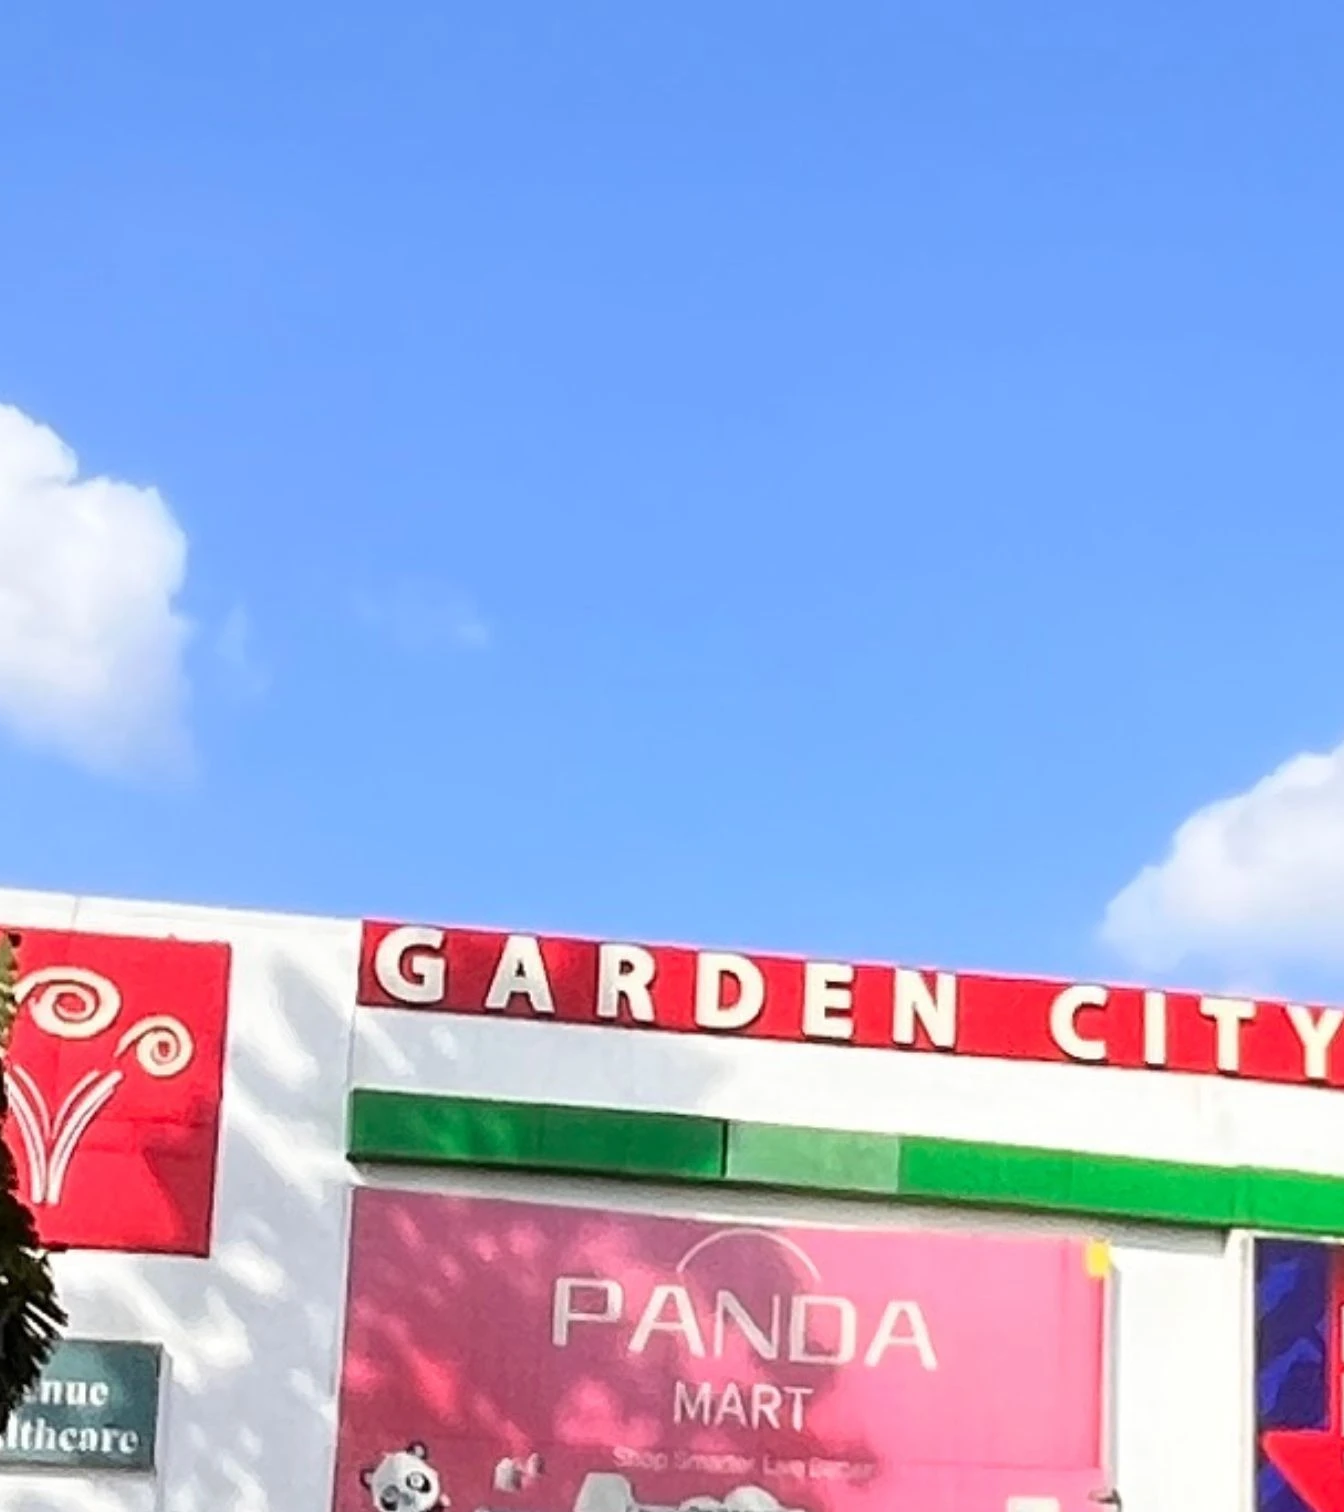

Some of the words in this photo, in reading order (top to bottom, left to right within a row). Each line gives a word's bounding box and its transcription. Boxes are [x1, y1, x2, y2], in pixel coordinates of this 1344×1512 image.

[373, 925, 957, 1050] GARDEN
[552, 1275, 938, 1371] PANDA
[672, 1381, 814, 1433] MART
